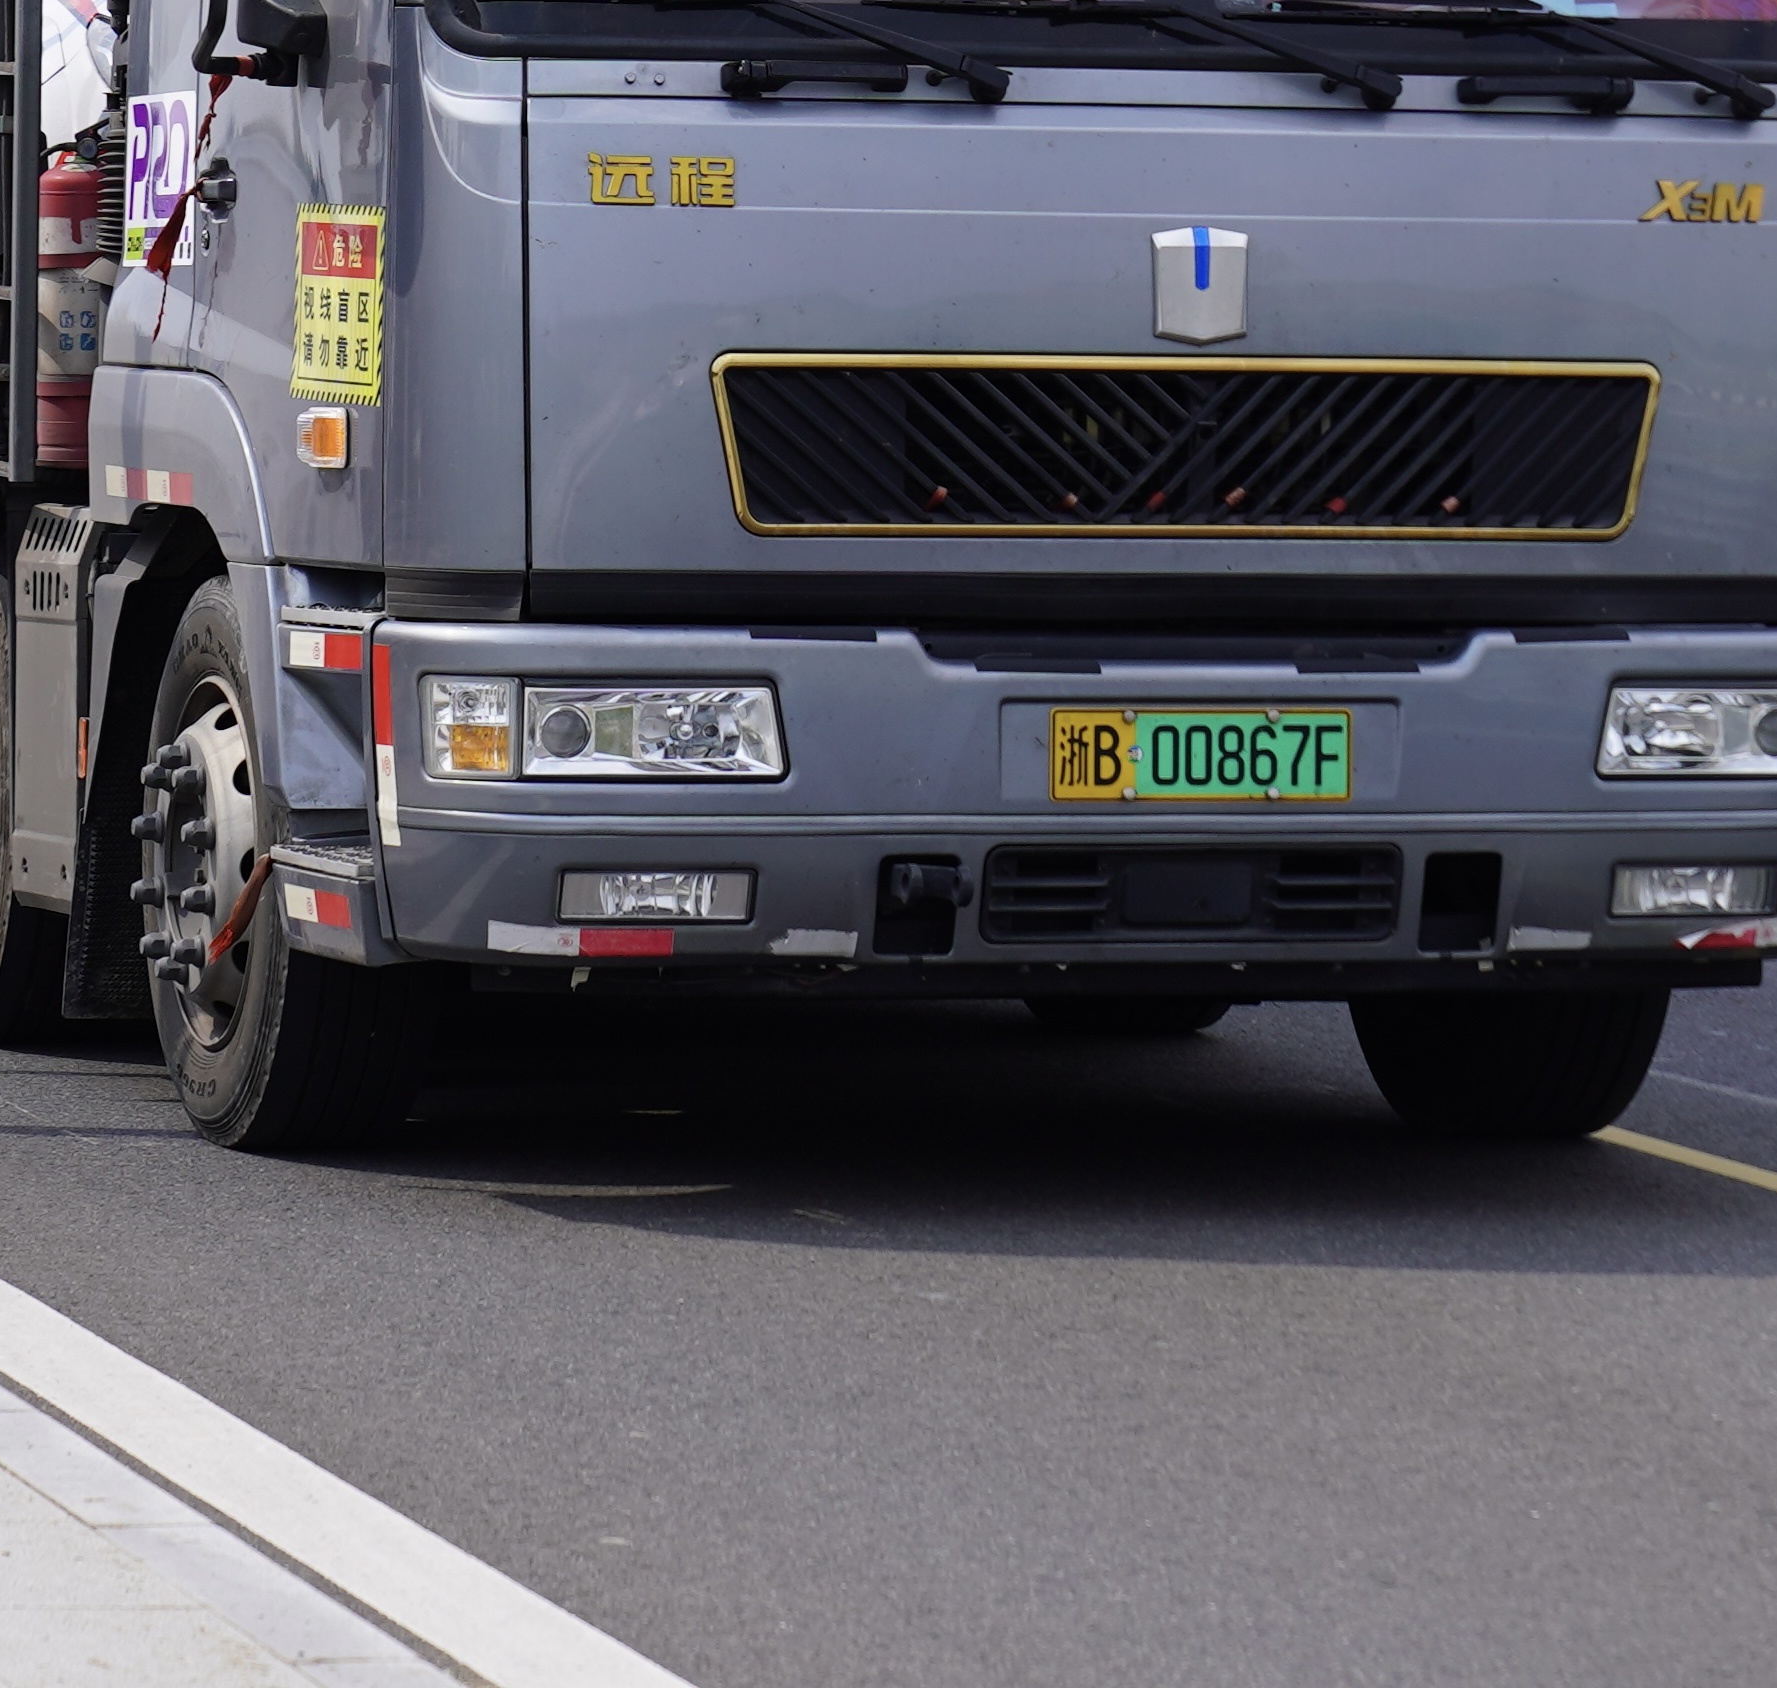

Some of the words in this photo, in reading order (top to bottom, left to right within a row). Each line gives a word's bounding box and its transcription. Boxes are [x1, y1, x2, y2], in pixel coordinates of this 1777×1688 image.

[587, 151, 737, 208] 远程
[331, 233, 364, 269] 危险
[303, 286, 371, 324] 视线盲区
[302, 331, 370, 373] 请勿靠近
[1151, 724, 1344, 787] 00867F
